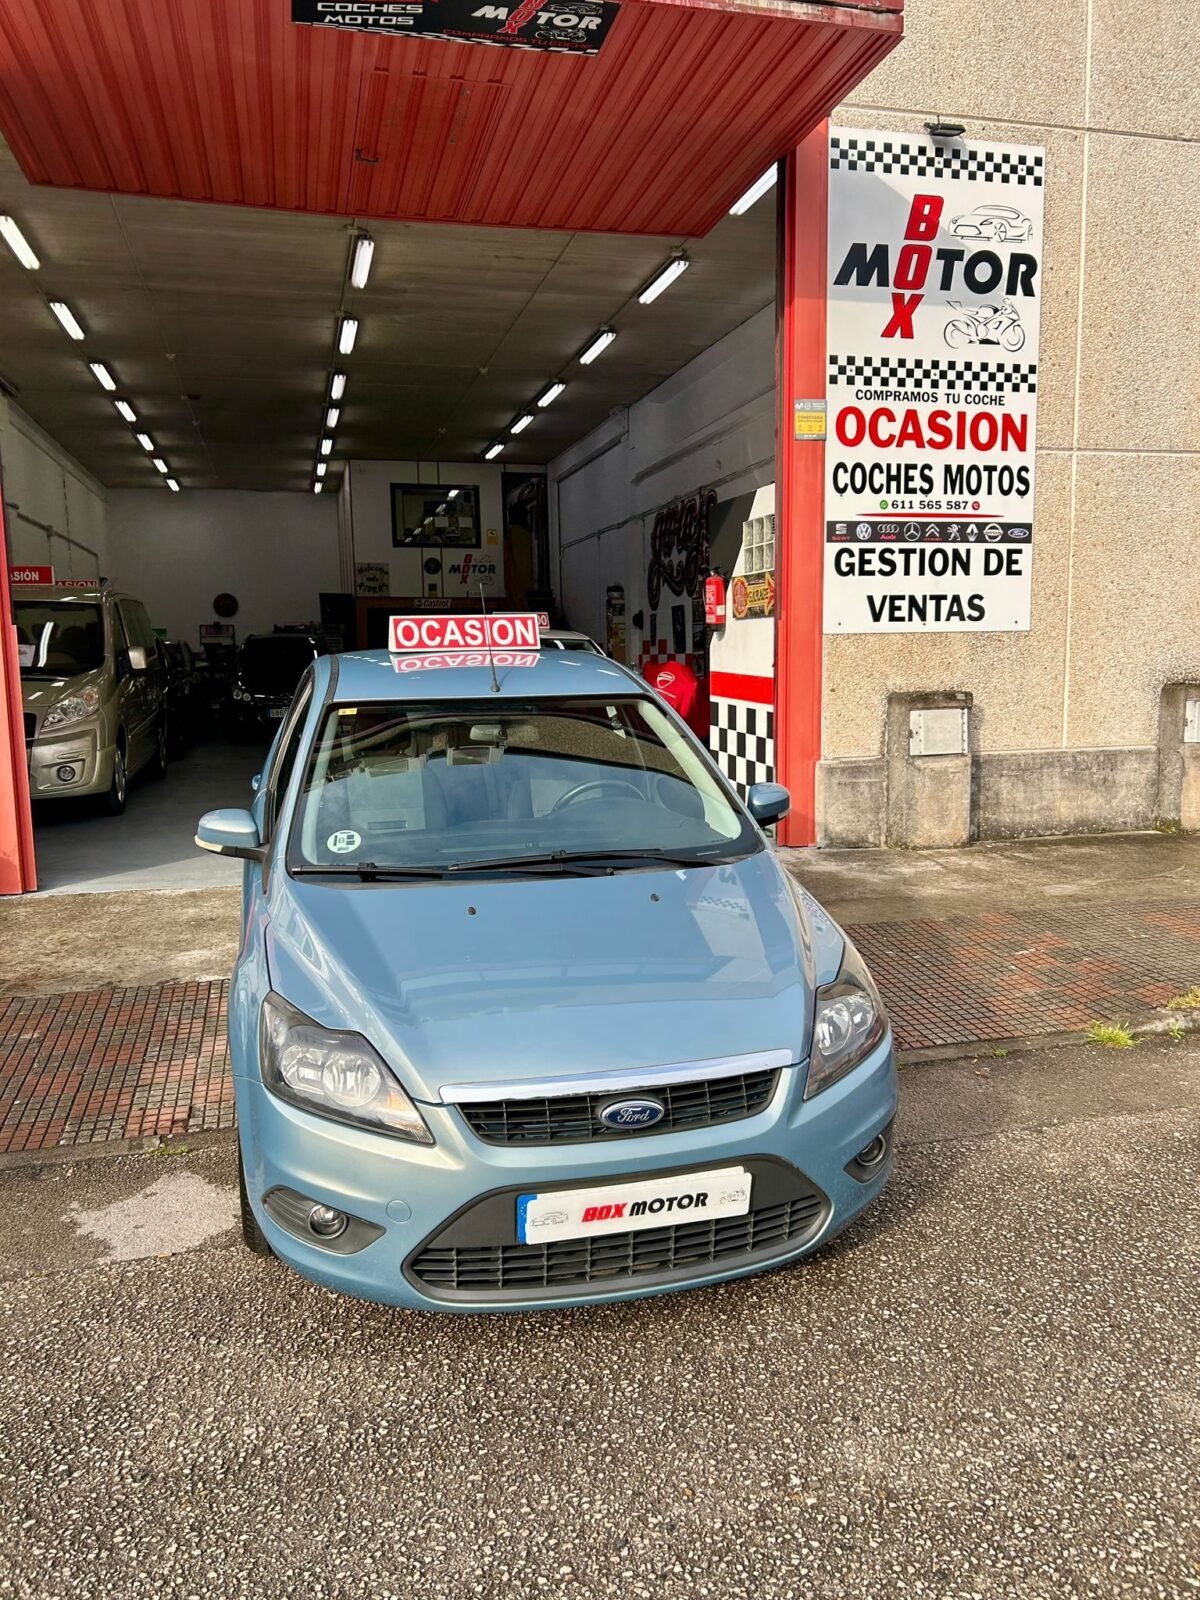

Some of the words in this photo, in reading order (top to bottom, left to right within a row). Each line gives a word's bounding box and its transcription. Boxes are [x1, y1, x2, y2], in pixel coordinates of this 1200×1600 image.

[317, 2, 424, 14] COCHES
[324, 14, 414, 25] MOTOS
[471, 5, 602, 30] MOTOR
[443, 28, 528, 44] COMPRAMOS
[531, 38, 547, 46] TU
[833, 242, 1038, 297] MOTOR
[855, 389, 938, 403] COMPRAMOS
[944, 392, 961, 405] TU
[964, 393, 1006, 406] COCHE
[835, 405, 1028, 452] OCASION
[832, 462, 934, 495] COCHES
[943, 464, 1031, 497] MOTOS
[891, 500, 914, 510] 611
[918, 500, 942, 510] 565
[946, 501, 969, 510] 587
[834, 547, 971, 577] GESTION
[983, 548, 1023, 576] DE
[866, 594, 986, 622] VENTAS
[396, 620, 535, 647] OCASION
[617, 1107, 650, 1123] Ford
[581, 1202, 627, 1223] BOX
[629, 1192, 709, 1217] MOTOR
